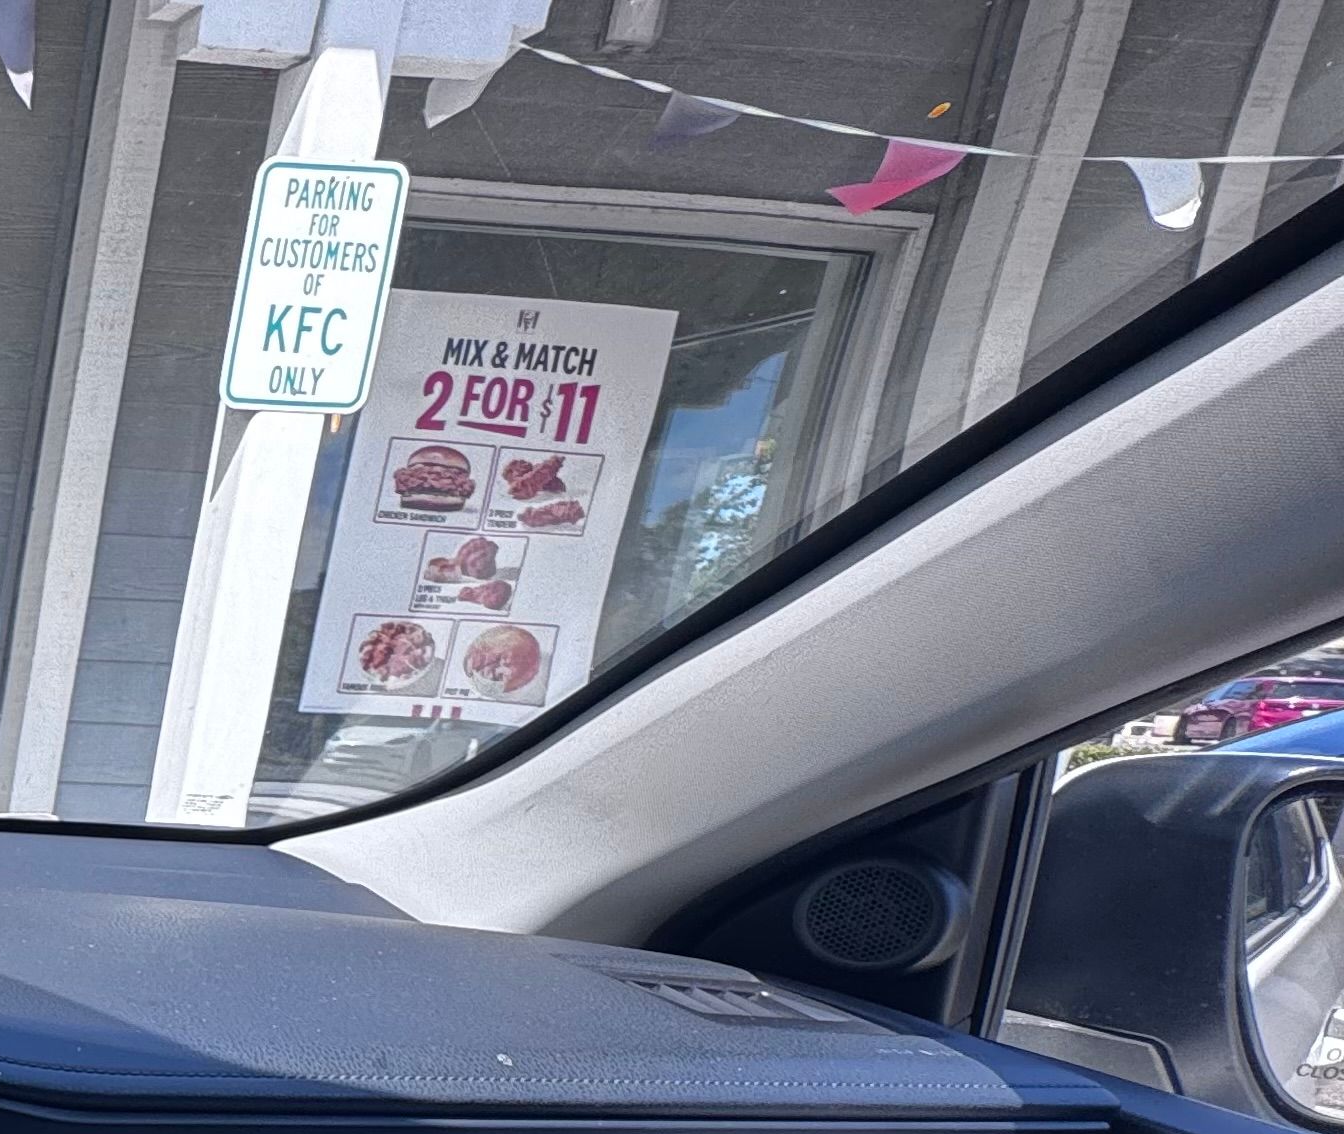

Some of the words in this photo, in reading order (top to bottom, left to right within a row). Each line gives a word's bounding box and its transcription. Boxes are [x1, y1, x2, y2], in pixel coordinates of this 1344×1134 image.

[284, 178, 376, 212] PARKING
[308, 213, 340, 237] FOR
[260, 238, 379, 273] CUSTOMERS
[303, 273, 325, 296] OF
[262, 304, 347, 356] KFC
[442, 338, 488, 367] MIX
[491, 341, 509, 369] &
[514, 342, 598, 376] MATCH
[269, 365, 325, 396] ONLY
[415, 371, 454, 431] 2
[459, 375, 535, 422] FOR
[540, 382, 601, 444] $11
